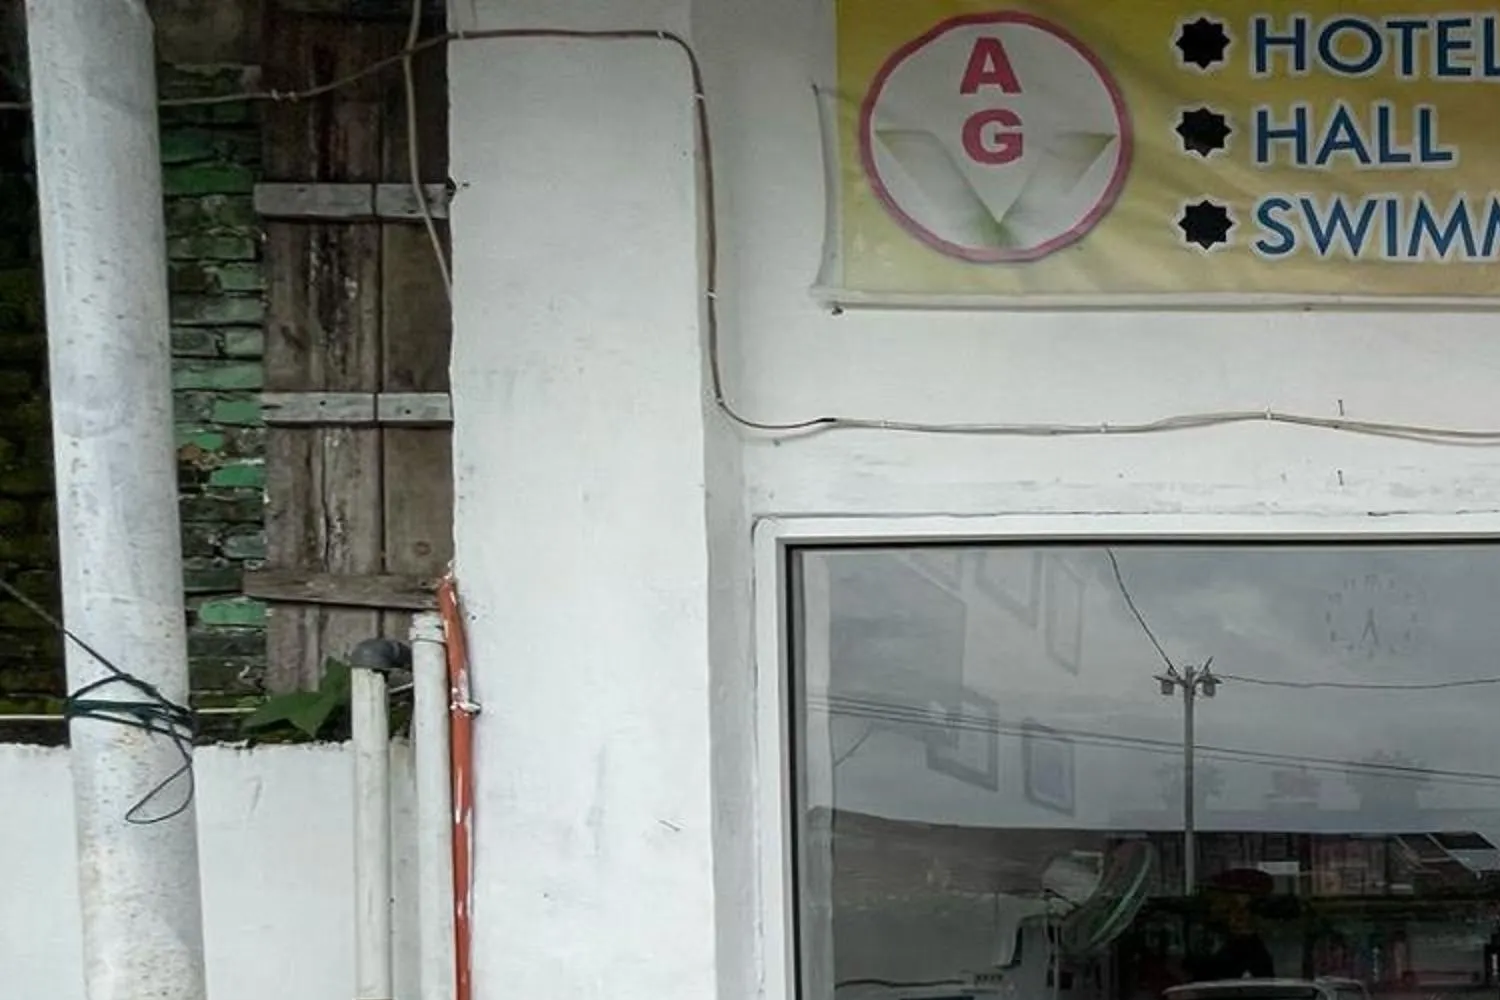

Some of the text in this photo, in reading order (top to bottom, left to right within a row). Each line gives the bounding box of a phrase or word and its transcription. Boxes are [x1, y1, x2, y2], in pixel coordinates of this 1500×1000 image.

[961, 37, 1021, 95] A
[963, 110, 1024, 164] G
[1257, 108, 1453, 163] HALL
